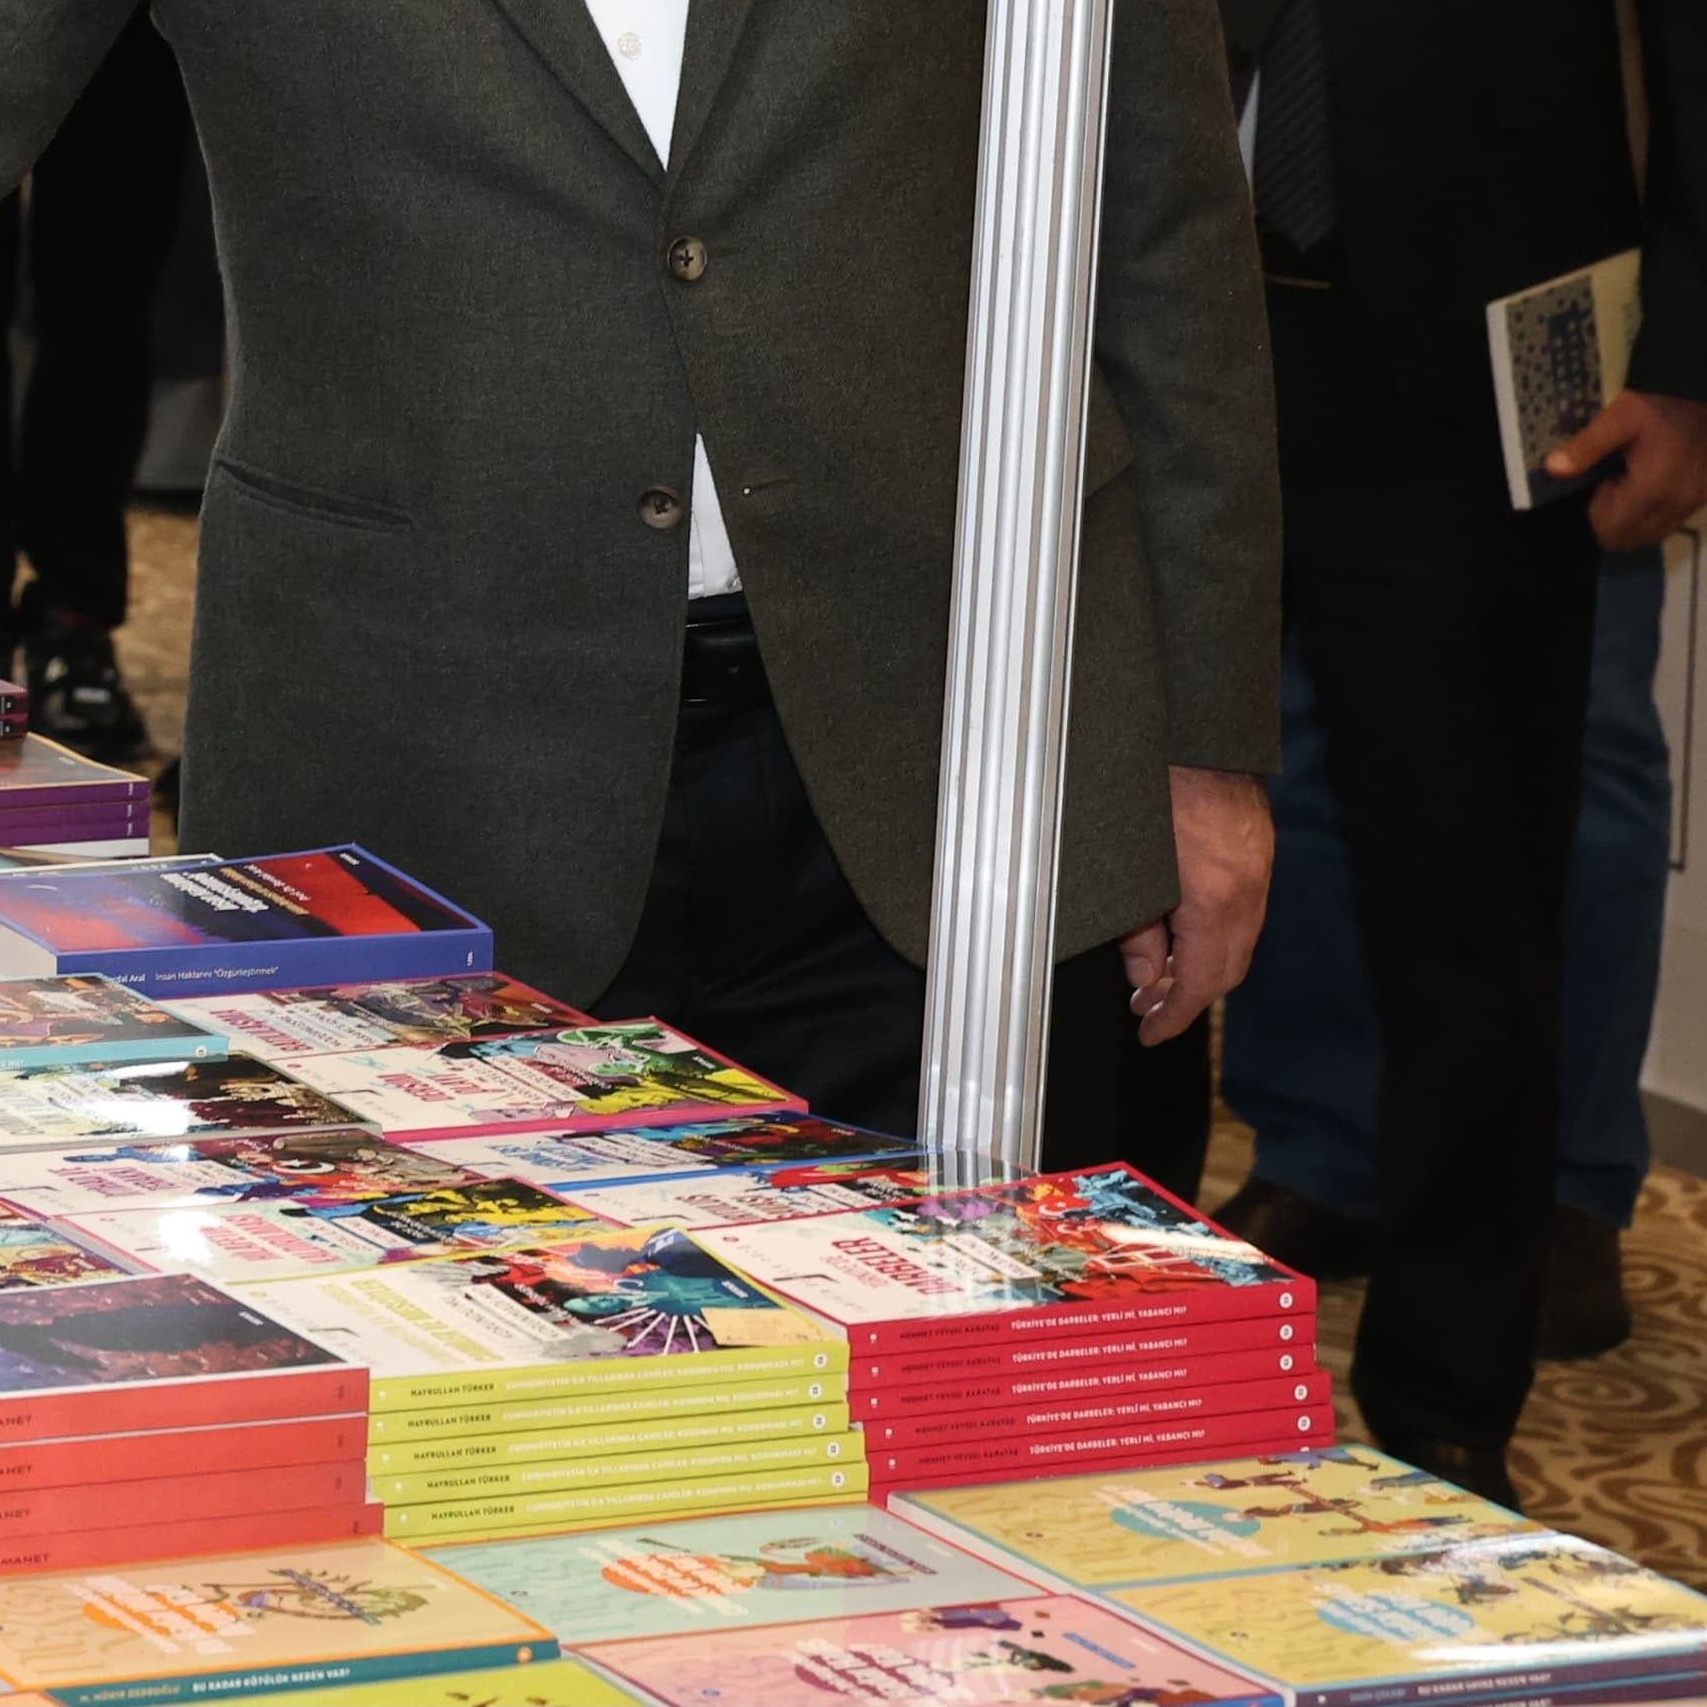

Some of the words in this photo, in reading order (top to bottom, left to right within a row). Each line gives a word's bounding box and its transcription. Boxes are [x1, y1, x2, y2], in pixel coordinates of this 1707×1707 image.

[1011, 1316, 1058, 1330] TÜRKİYE'DE
[1138, 1307, 1173, 1319] YABANCI
[1012, 1349, 1058, 1363] TÜRKİYE'DE
[1138, 1339, 1173, 1351] YABANCI
[461, 1383, 495, 1394] TÜRKER
[1012, 1380, 1058, 1394] TÜRKİYE'DE
[1138, 1370, 1173, 1381] YABANCI
[459, 1414, 491, 1425] TÜRKER
[1026, 1410, 1072, 1424] TÜRKİYE'DE
[1152, 1400, 1187, 1411] YABANCI
[1030, 1441, 1076, 1455] TÜRKİYE'DE
[1156, 1430, 1190, 1442] YABANCI
[465, 1446, 497, 1457] TÜRKER
[478, 1475, 510, 1485] TÜRKER
[482, 1506, 515, 1517] TÜRKER
